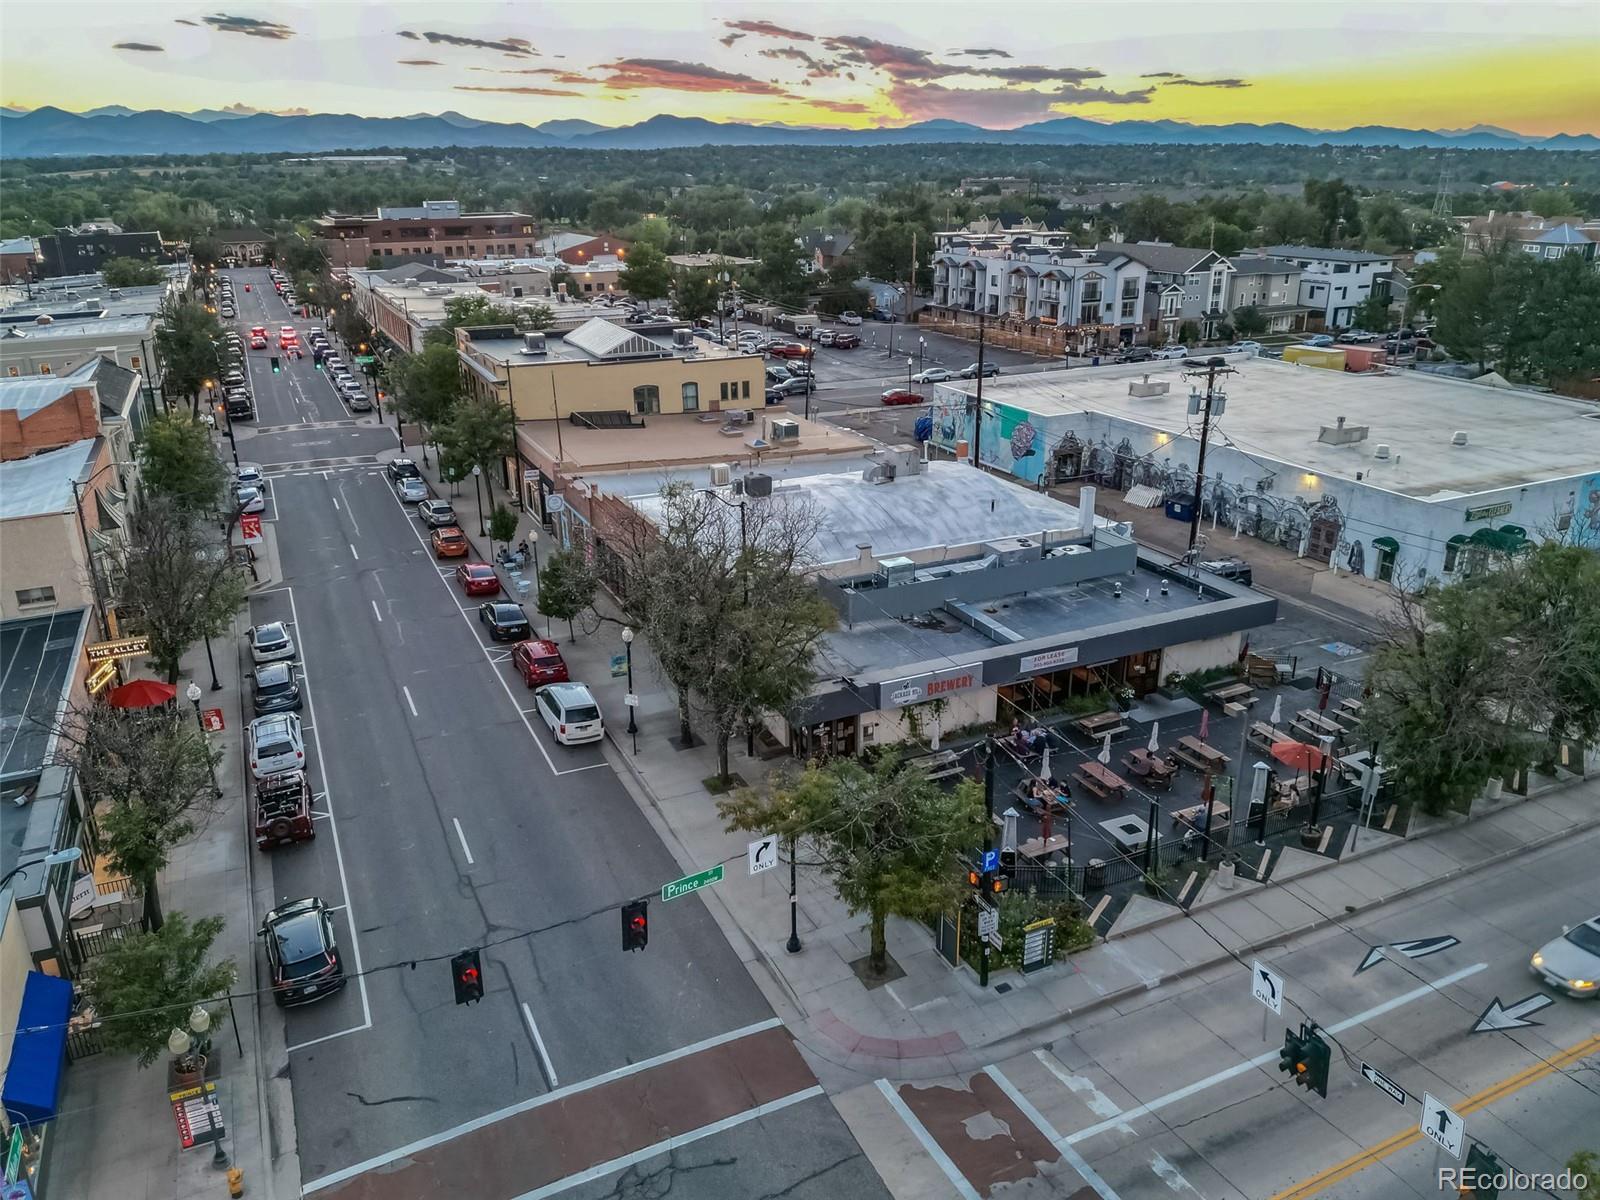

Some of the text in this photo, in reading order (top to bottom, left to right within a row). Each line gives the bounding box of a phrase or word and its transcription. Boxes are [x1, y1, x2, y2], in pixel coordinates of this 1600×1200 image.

[89, 643, 146, 659] THE ALLEY
[1033, 650, 1066, 662] FOR LEASE
[927, 675, 974, 696] BREWERY
[752, 859, 775, 872] ONLY
[667, 878, 699, 898] Prince
[1255, 988, 1279, 1010] ONLY
[1374, 1076, 1401, 1098] ONE WAY
[1426, 1125, 1455, 1150] ONLY
